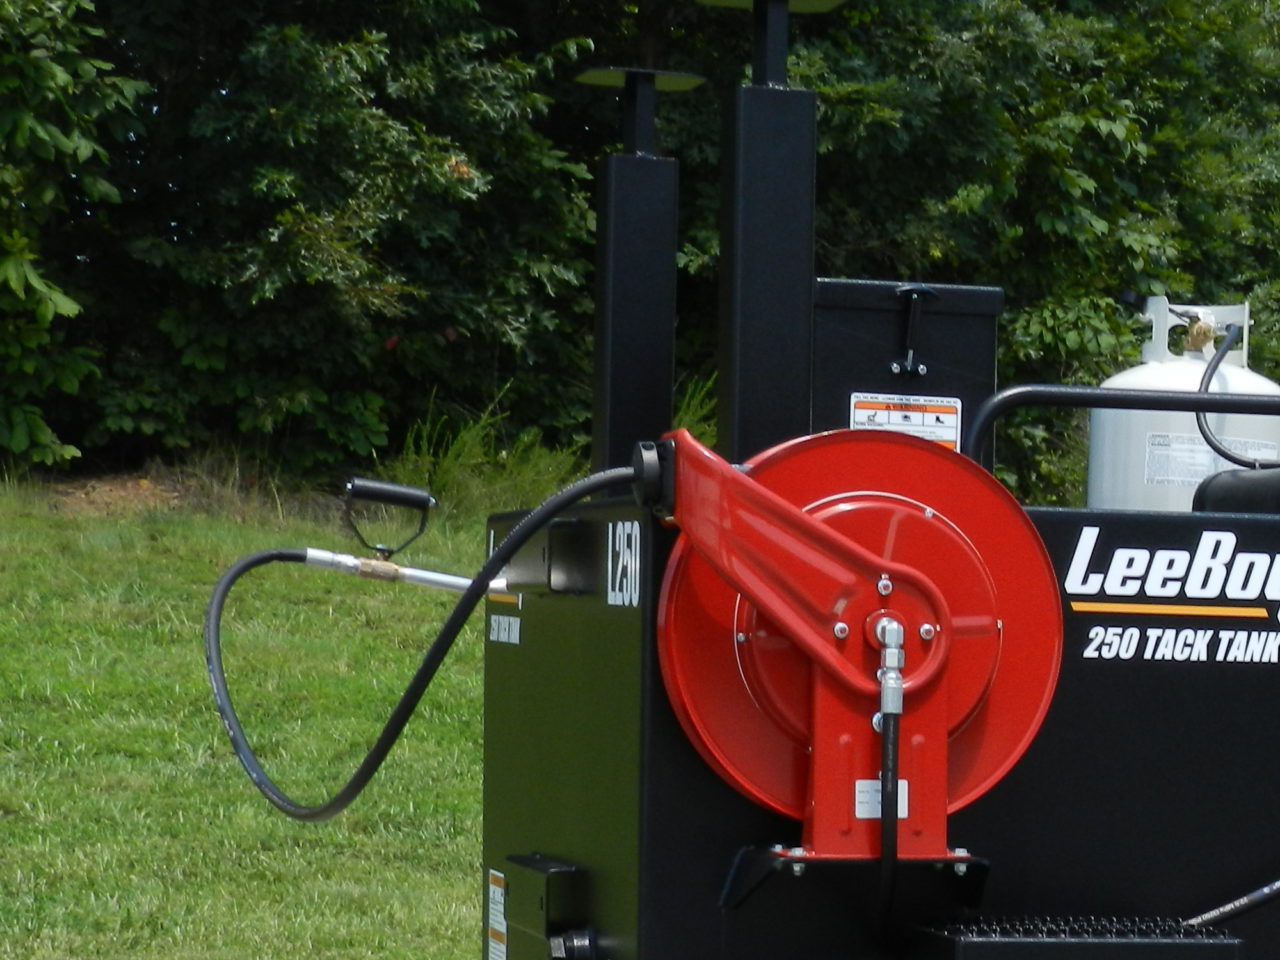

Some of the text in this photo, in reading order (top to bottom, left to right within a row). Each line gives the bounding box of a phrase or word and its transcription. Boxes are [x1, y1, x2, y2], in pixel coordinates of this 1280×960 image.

[608, 520, 641, 607] L250
[1083, 626, 1140, 660] 250
[1143, 628, 1214, 662] TACK
